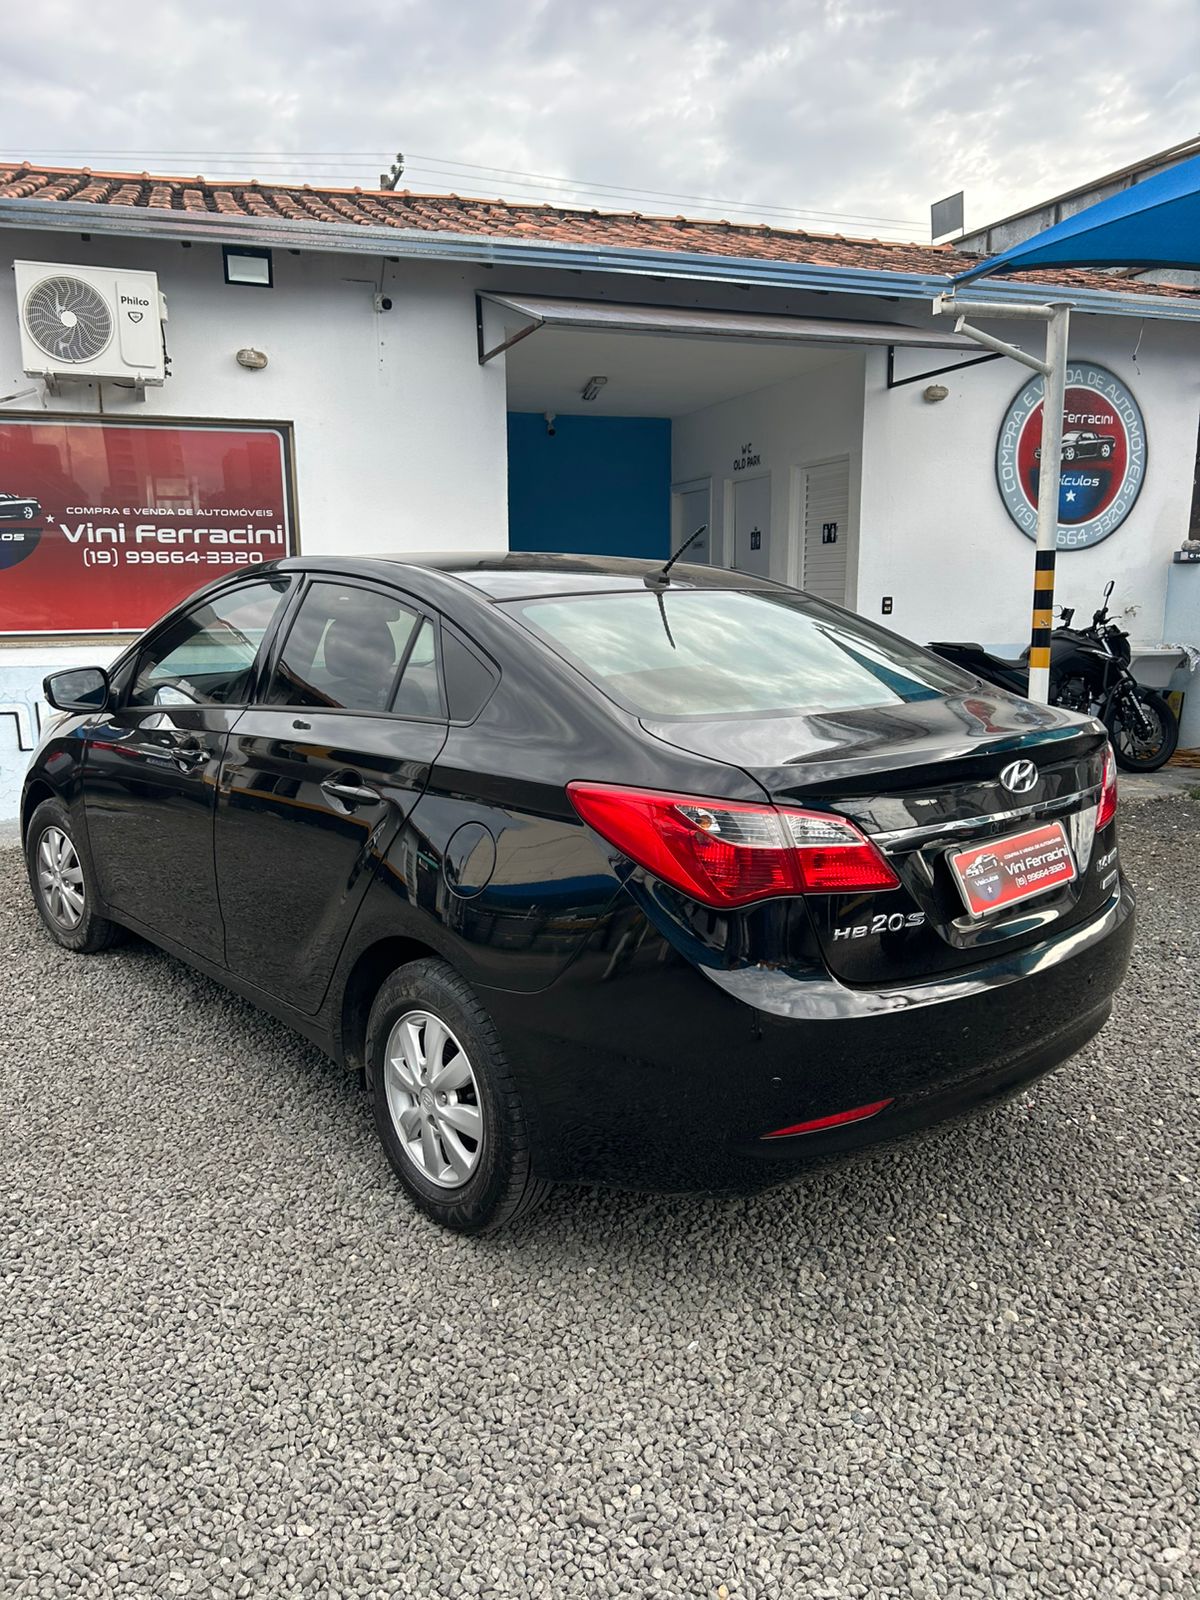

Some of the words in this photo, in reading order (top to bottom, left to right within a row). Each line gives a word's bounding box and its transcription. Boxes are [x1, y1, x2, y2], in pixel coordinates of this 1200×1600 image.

[120, 296, 150, 306] Philco
[1002, 410, 1026, 493] COMPRA
[1023, 391, 1036, 408] E
[1087, 371, 1106, 389] DE
[1104, 383, 1145, 496] AUTOMÓVEIS
[1058, 474, 1100, 487] ículos
[66, 506, 120, 516] COMPRA
[122, 507, 131, 516] E
[133, 508, 176, 516] VENDA
[177, 508, 194, 516] DE
[197, 508, 273, 517] AUTOMÓVEIS
[59, 523, 126, 543] Vini
[135, 524, 284, 544] Ferracini
[83, 547, 119, 568] (19)
[125, 550, 263, 565] 99664-3320
[1005, 860, 1026, 875] Vini
[1025, 845, 1068, 869] Ferracini
